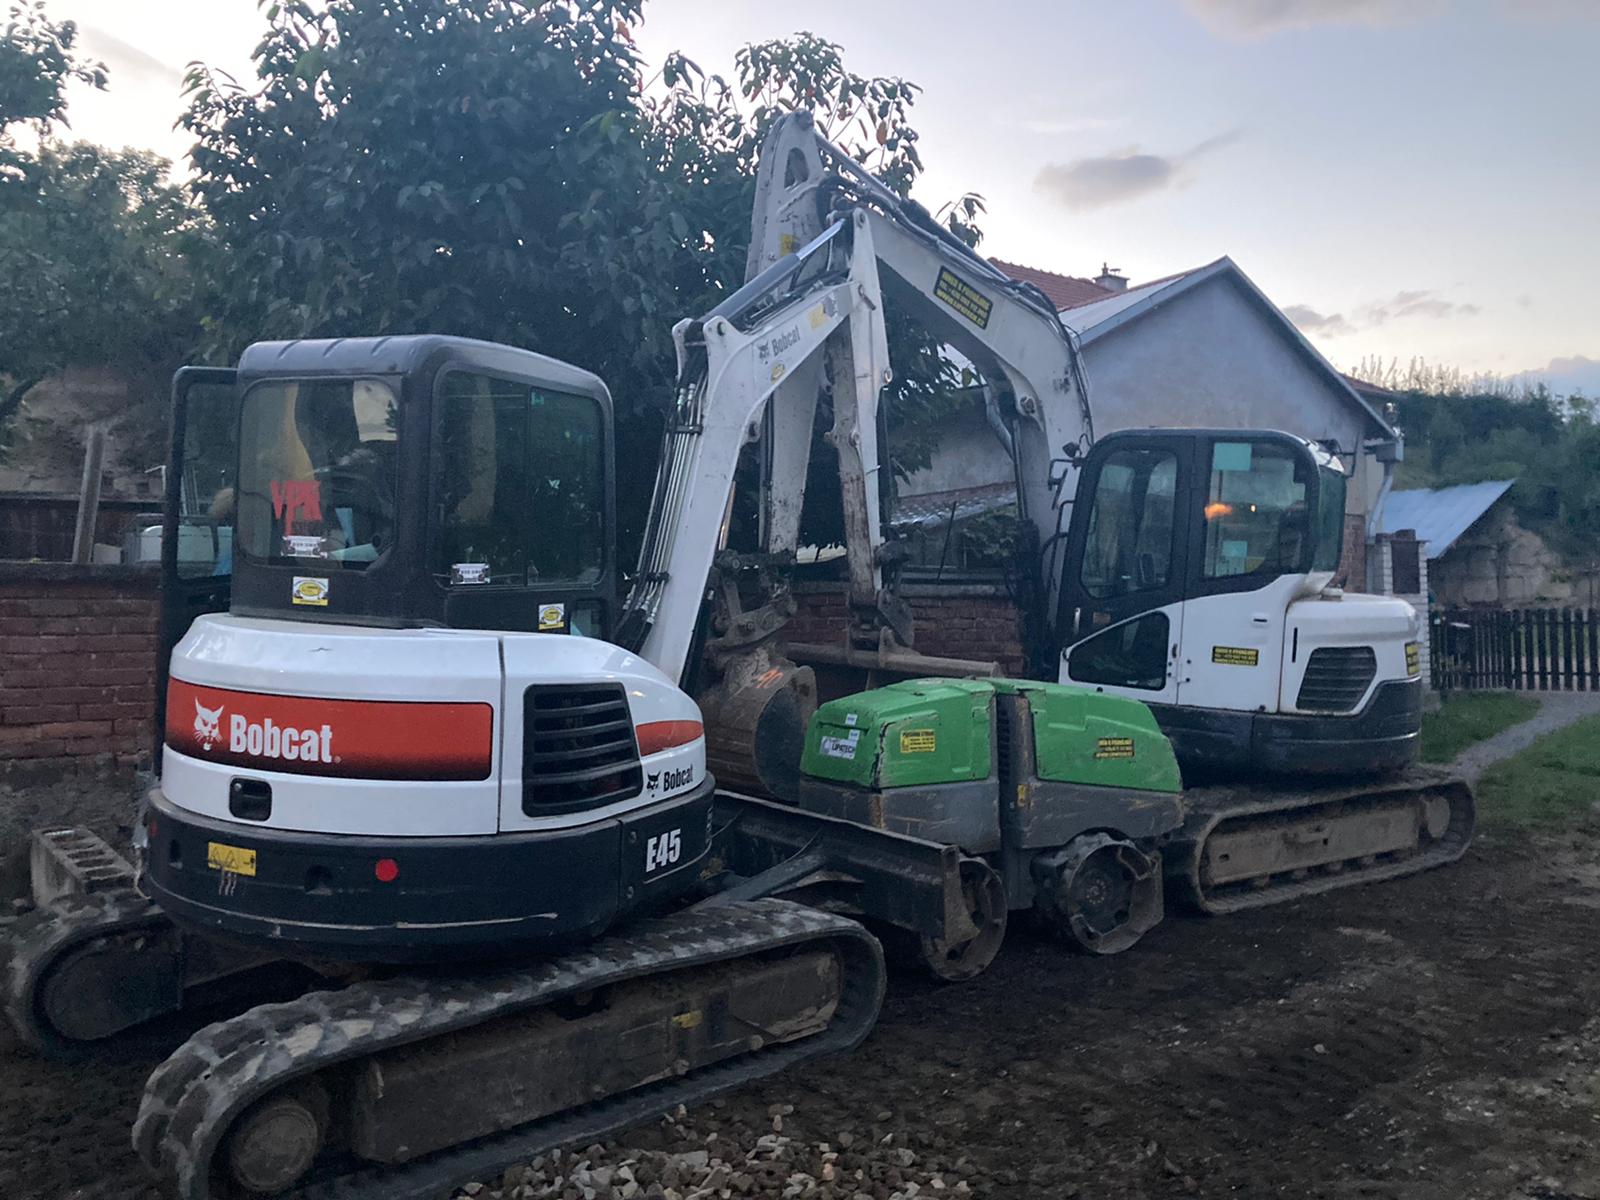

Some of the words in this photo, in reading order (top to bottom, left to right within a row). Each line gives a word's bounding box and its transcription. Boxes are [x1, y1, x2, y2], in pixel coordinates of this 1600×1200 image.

[771, 324, 801, 357] Bobcat
[229, 714, 333, 764] Bobcat
[663, 763, 694, 793] Bobcat
[645, 828, 682, 873] E45
